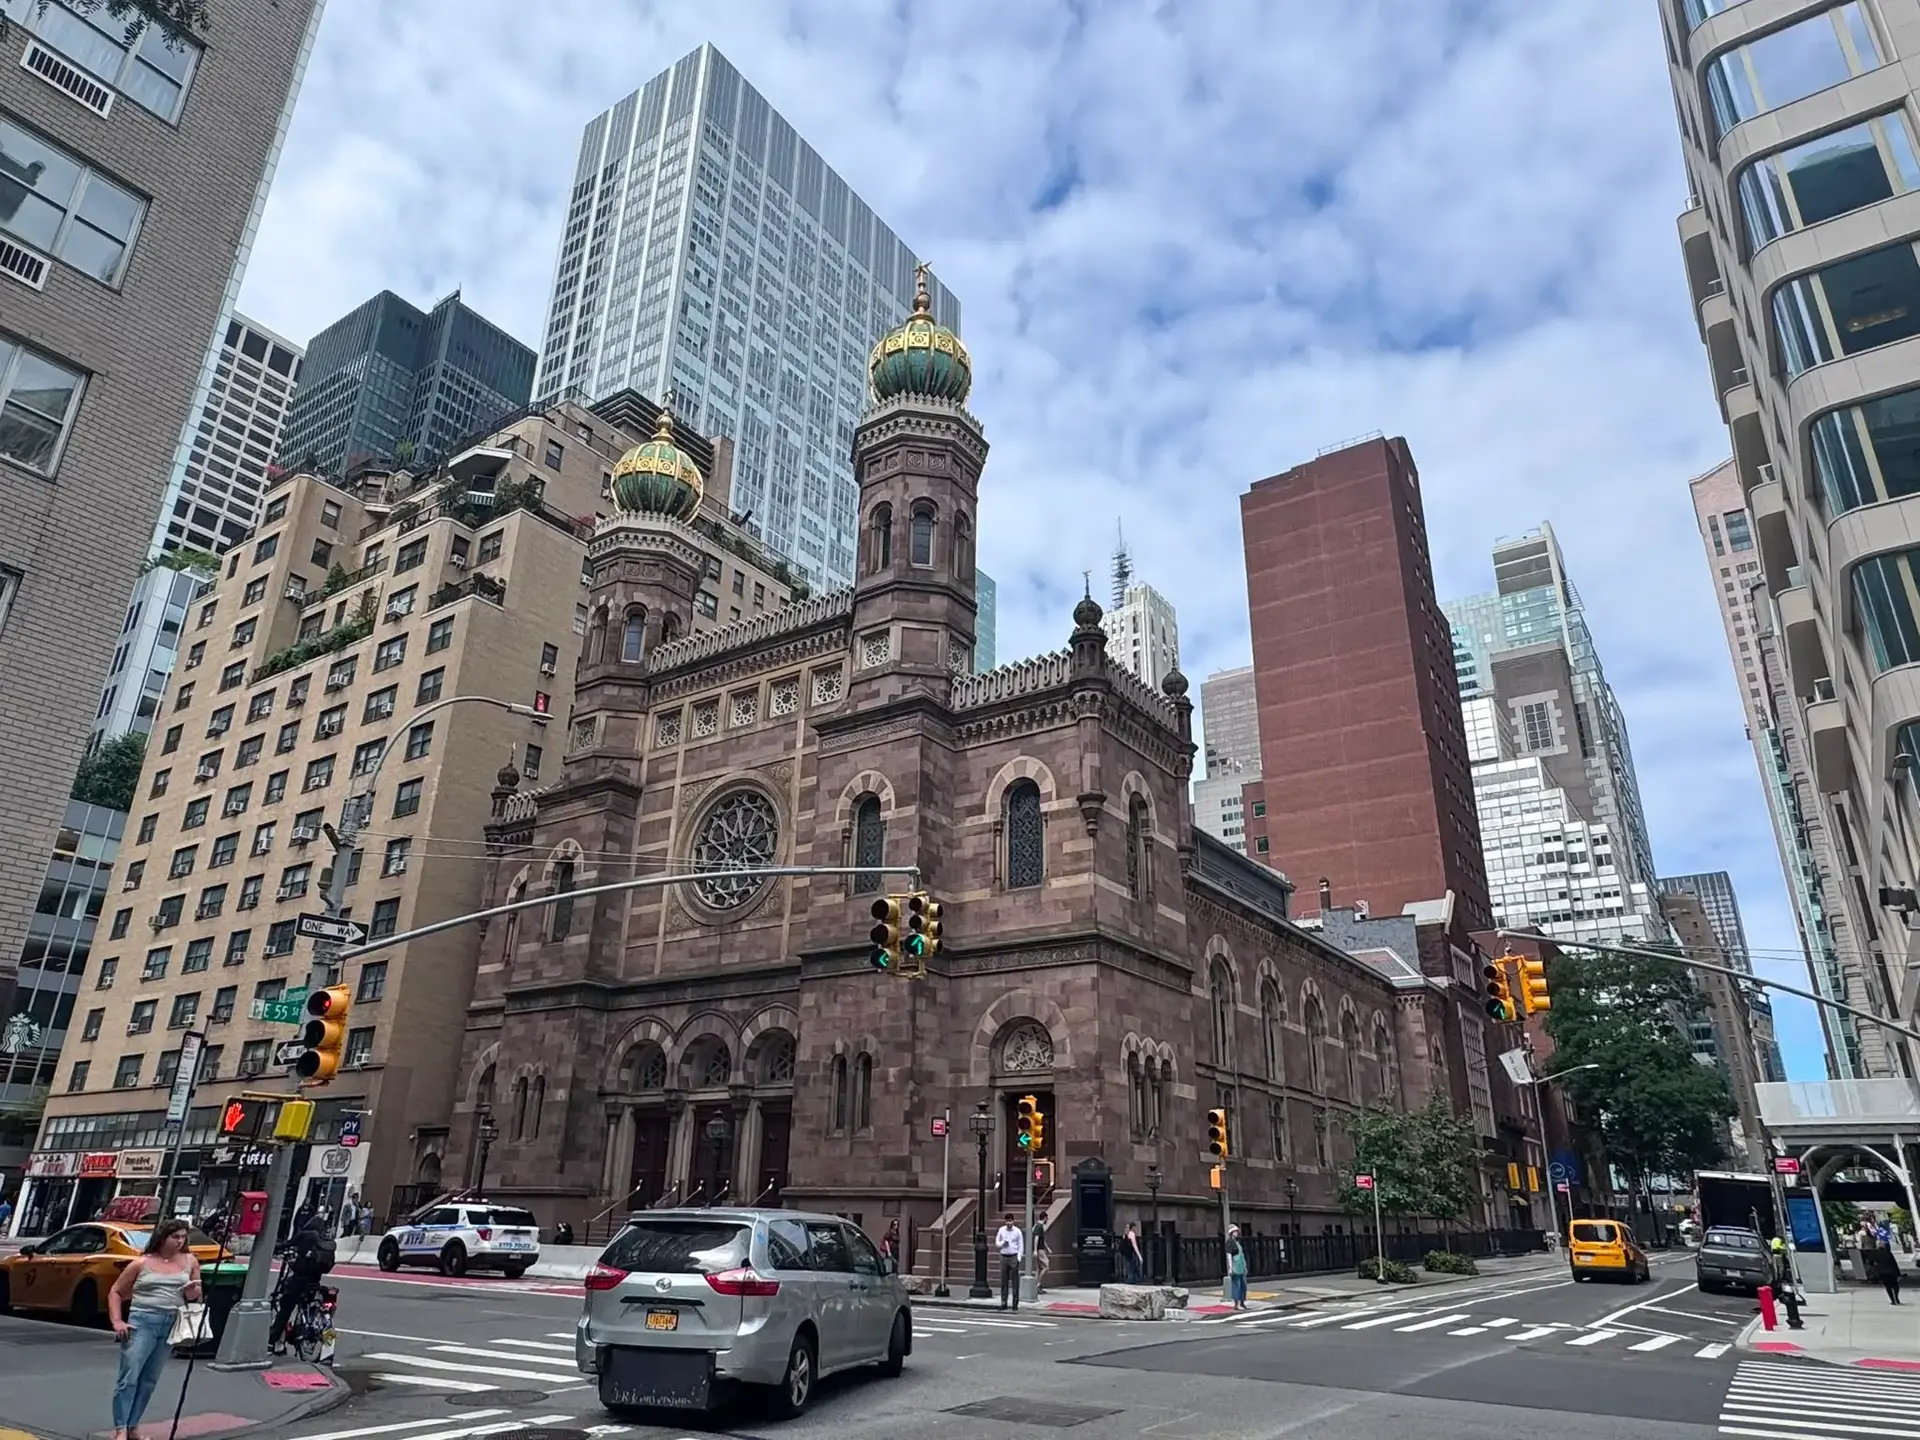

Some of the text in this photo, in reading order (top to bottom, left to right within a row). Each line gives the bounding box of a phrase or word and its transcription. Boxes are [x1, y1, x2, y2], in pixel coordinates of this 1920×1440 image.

[304, 920, 357, 937] ONE WAY
[263, 1003, 271, 1018] E
[274, 1004, 288, 1019] 55
